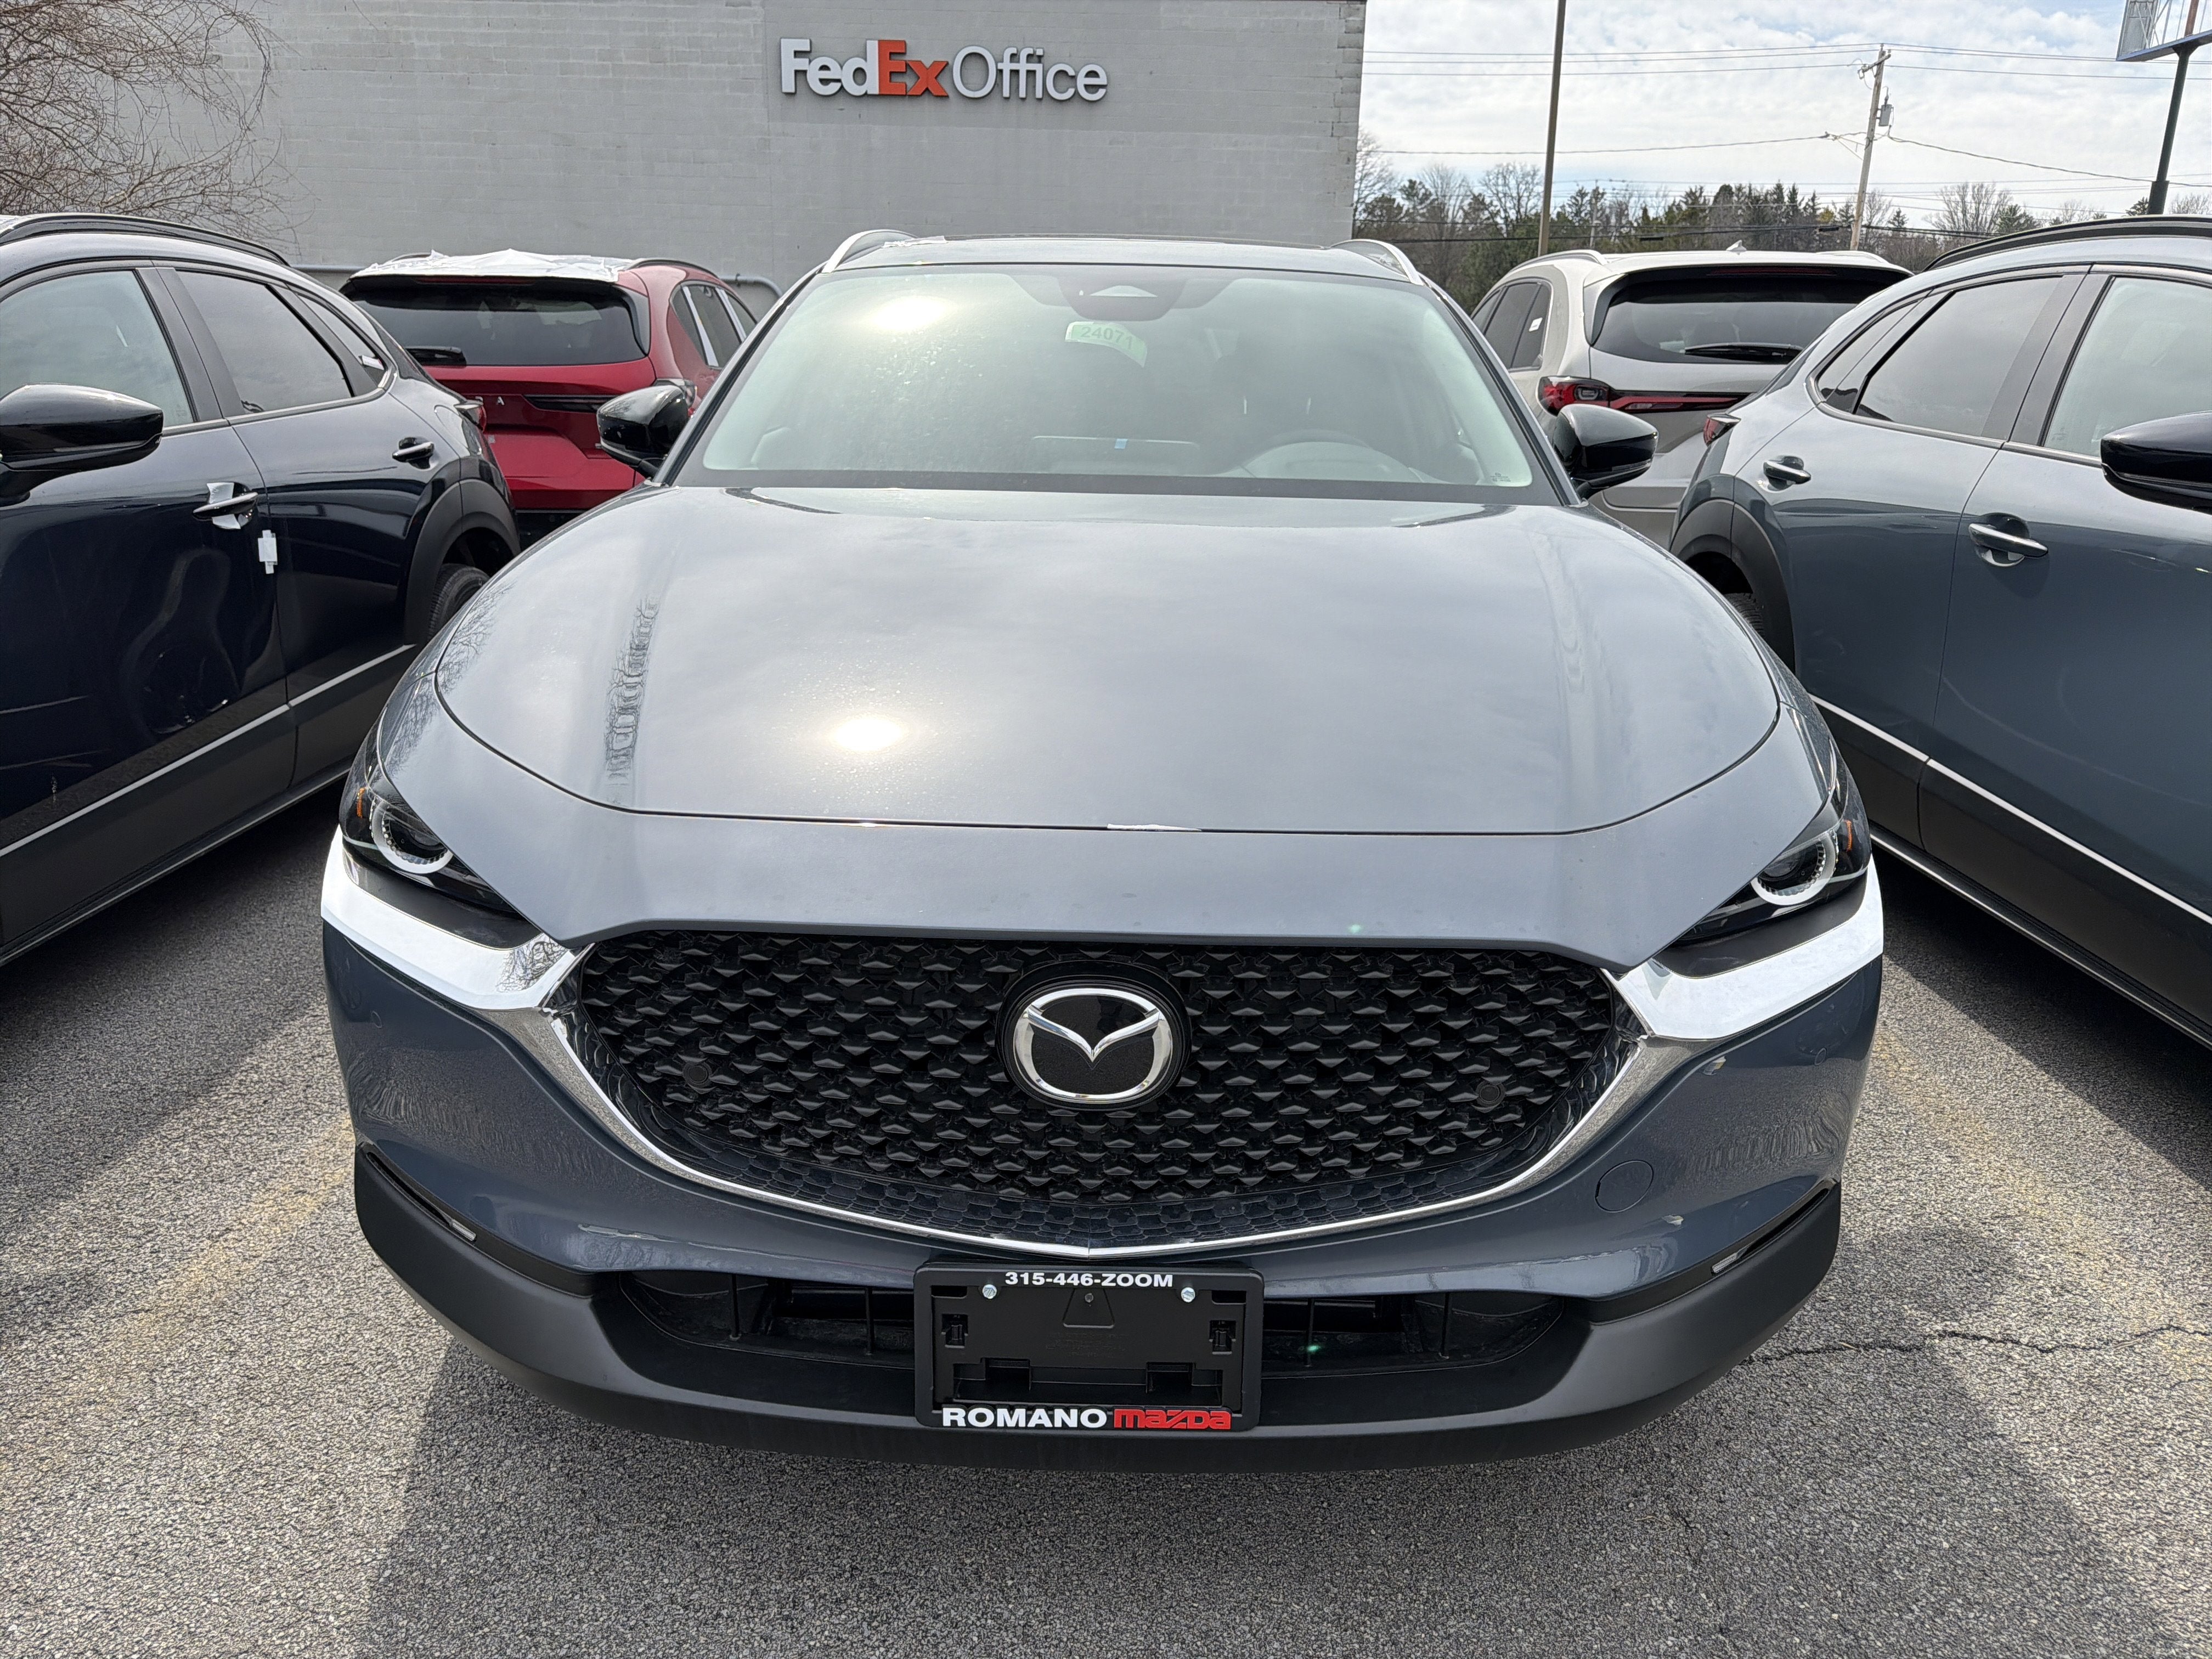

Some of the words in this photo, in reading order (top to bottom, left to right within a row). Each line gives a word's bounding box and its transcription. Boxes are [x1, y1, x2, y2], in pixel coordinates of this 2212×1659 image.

[780, 38, 949, 97] FedEx
[952, 46, 1108, 101] Office
[1080, 326, 1133, 350] 24071
[1005, 1271, 1173, 1288] 315-446-ZOOM
[942, 1407, 1107, 1429] ROMANO
